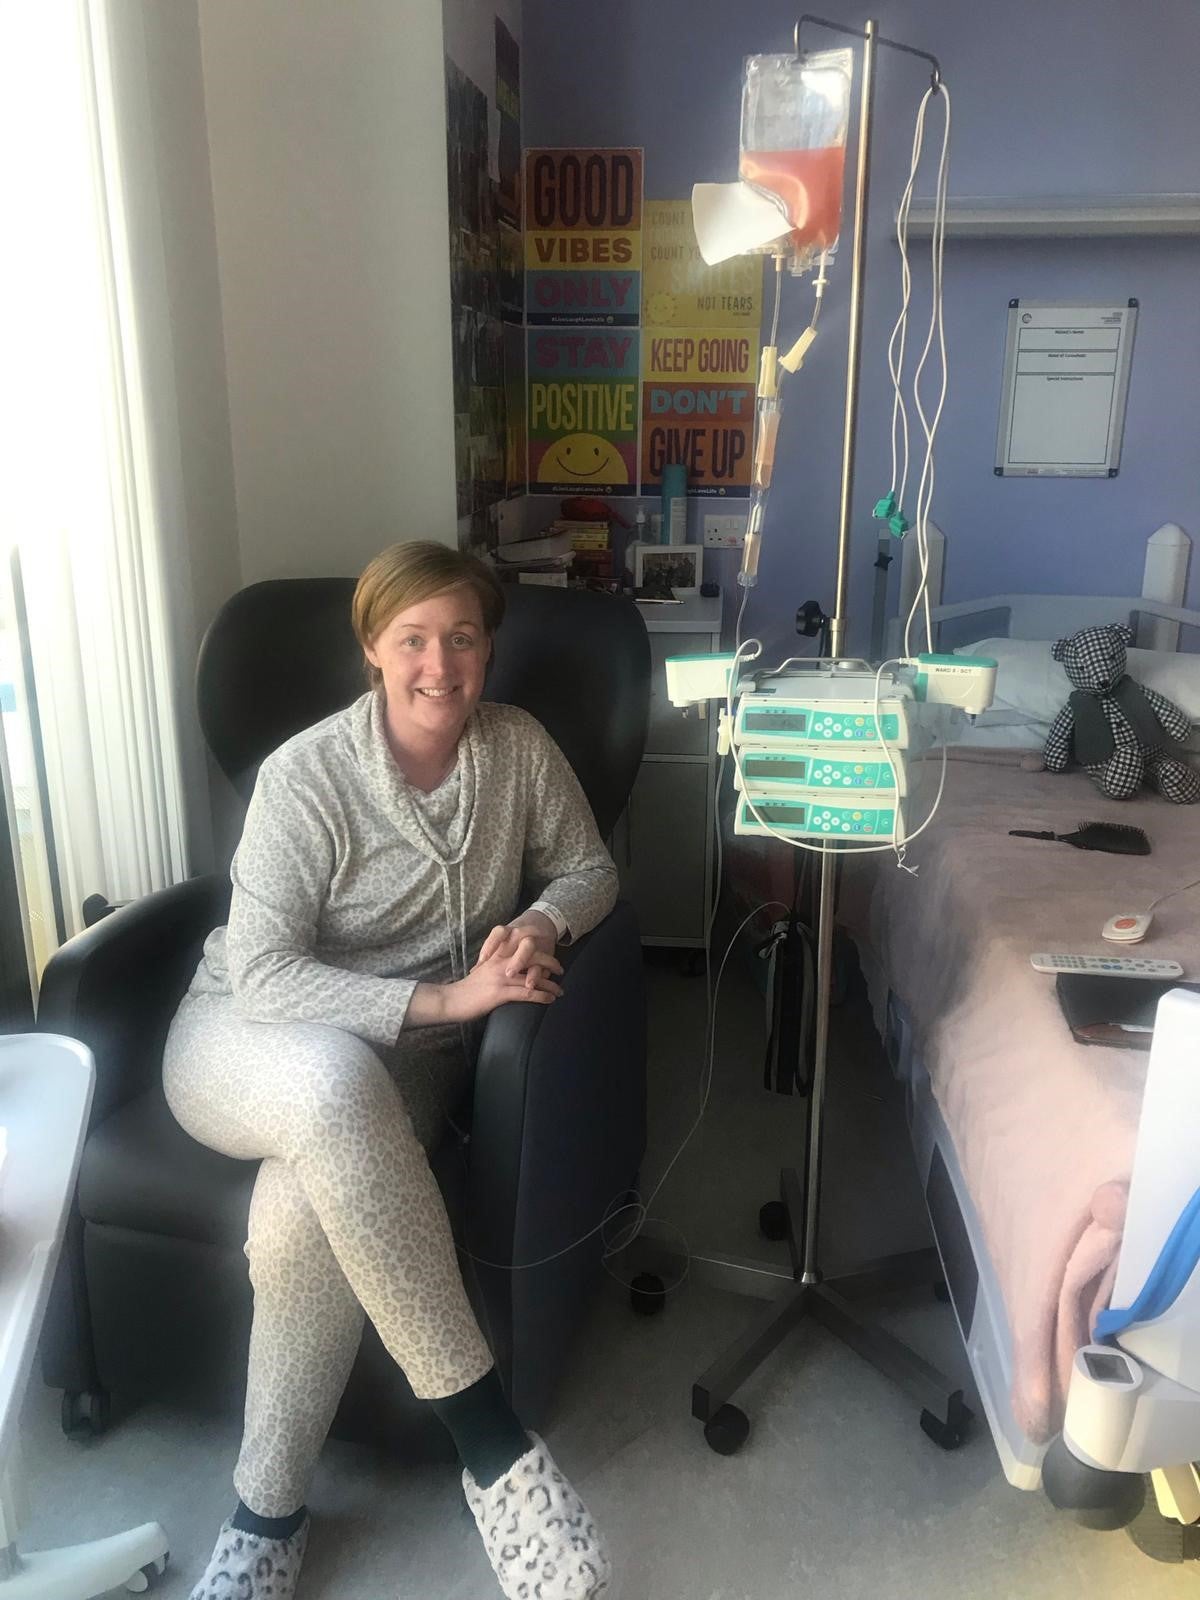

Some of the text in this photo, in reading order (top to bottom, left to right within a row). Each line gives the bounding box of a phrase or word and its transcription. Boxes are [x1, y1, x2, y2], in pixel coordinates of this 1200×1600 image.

[534, 155, 634, 228] GOOD
[651, 211, 686, 225] COUNT
[535, 237, 633, 263] VIBES
[650, 246, 684, 260] COUNT
[536, 276, 633, 308] ONLY
[697, 296, 753, 311] NOT TEARS
[536, 336, 632, 368] STAY
[651, 338, 750, 373] KEEP GOING
[532, 383, 635, 431] POSITIVE
[650, 389, 748, 415] DON'T
[649, 427, 746, 478] GIVE UP
